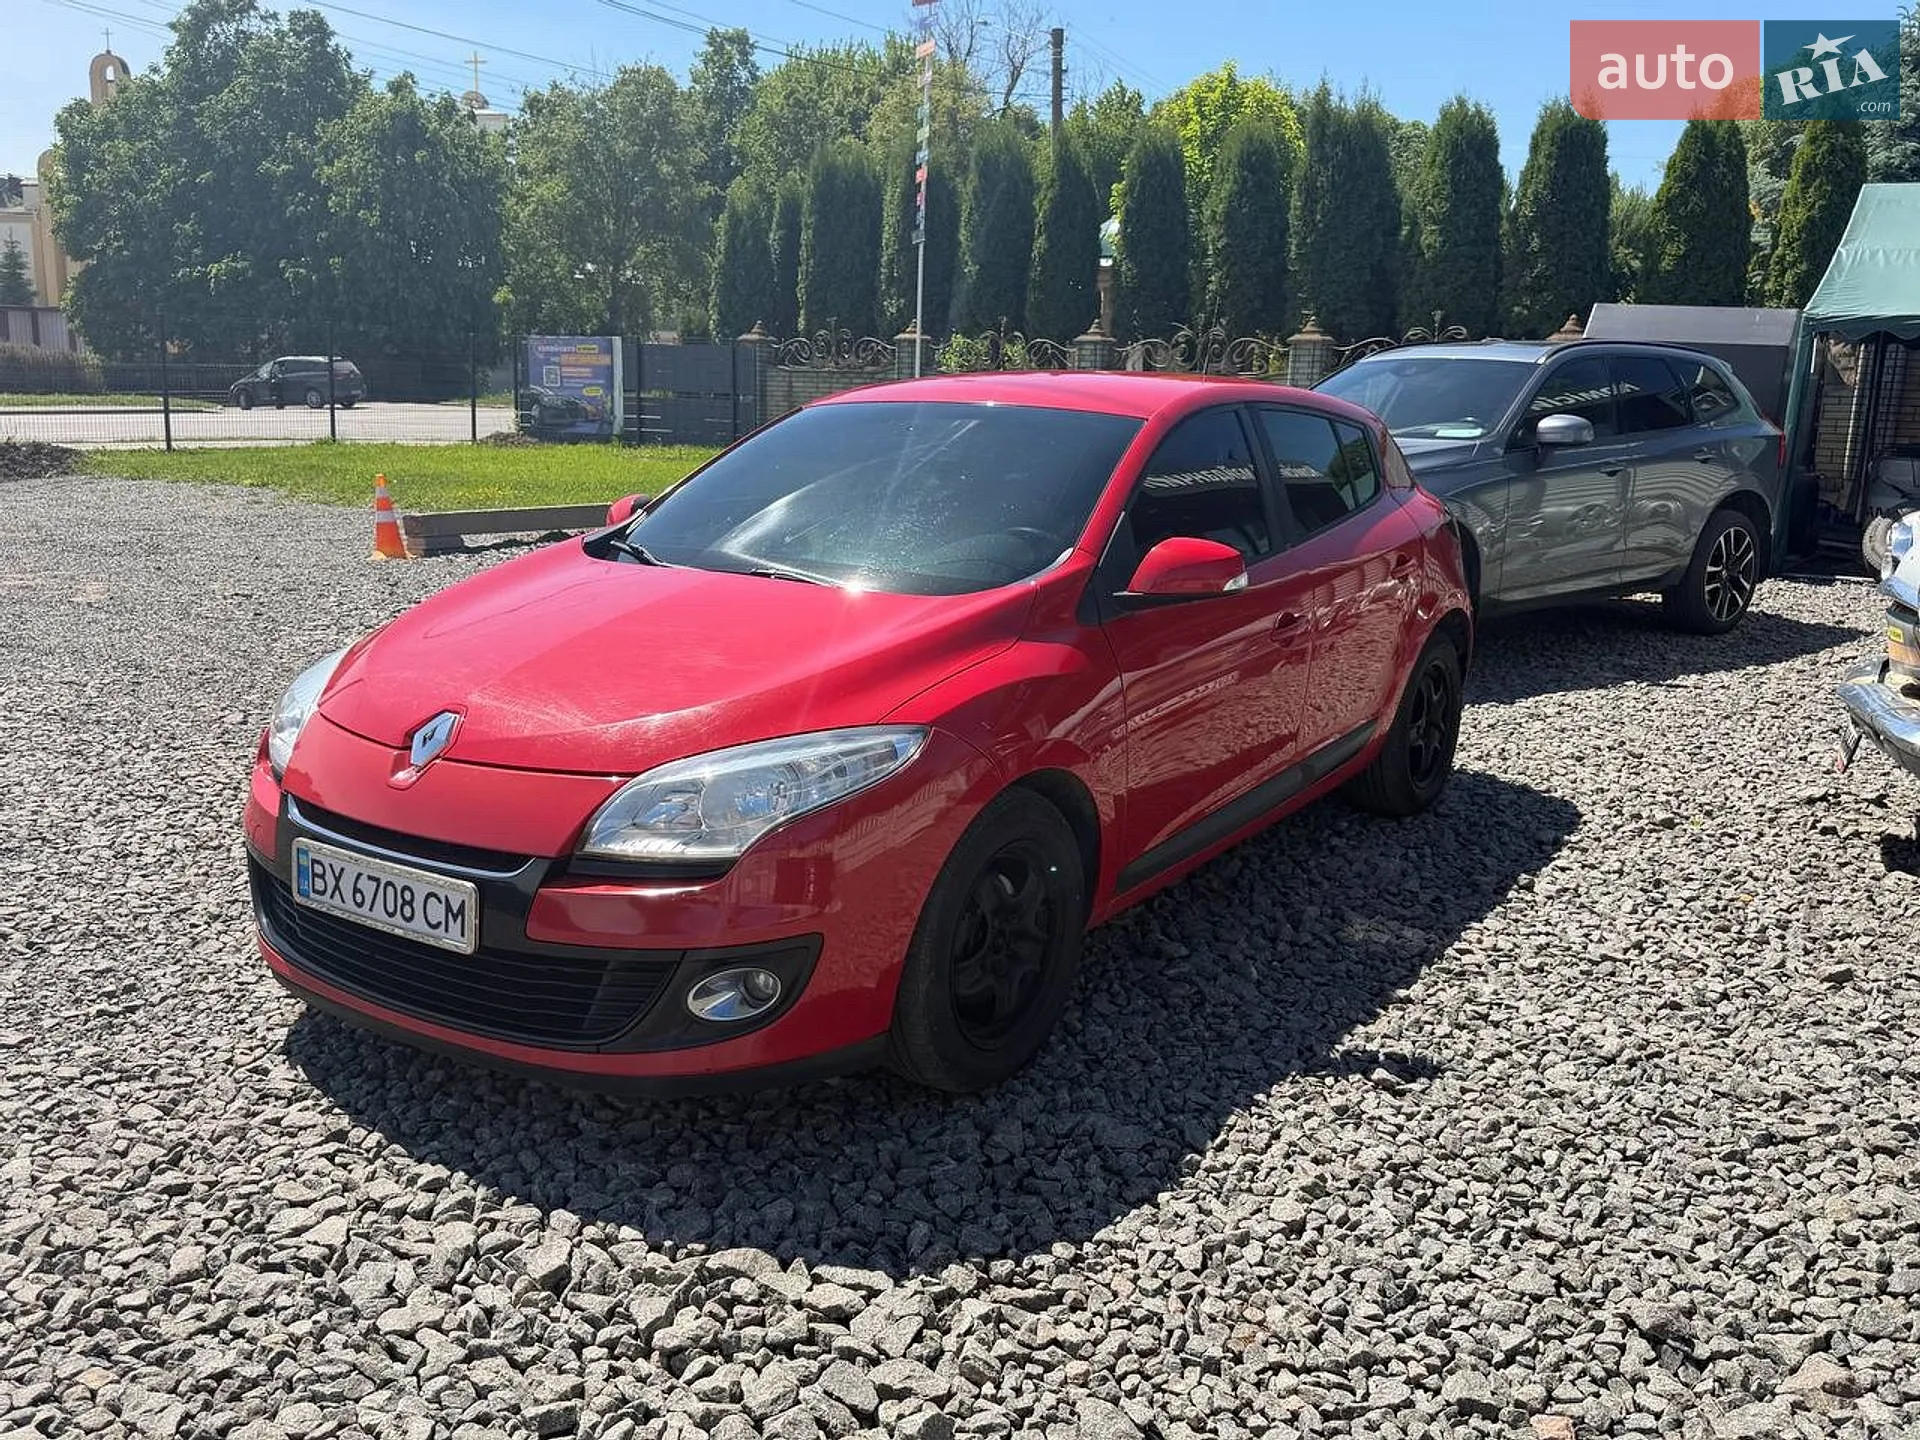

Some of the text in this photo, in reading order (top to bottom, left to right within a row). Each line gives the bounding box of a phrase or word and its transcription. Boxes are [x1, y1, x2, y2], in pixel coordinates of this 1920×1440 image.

[311, 858, 466, 938] BX 6708 CM
